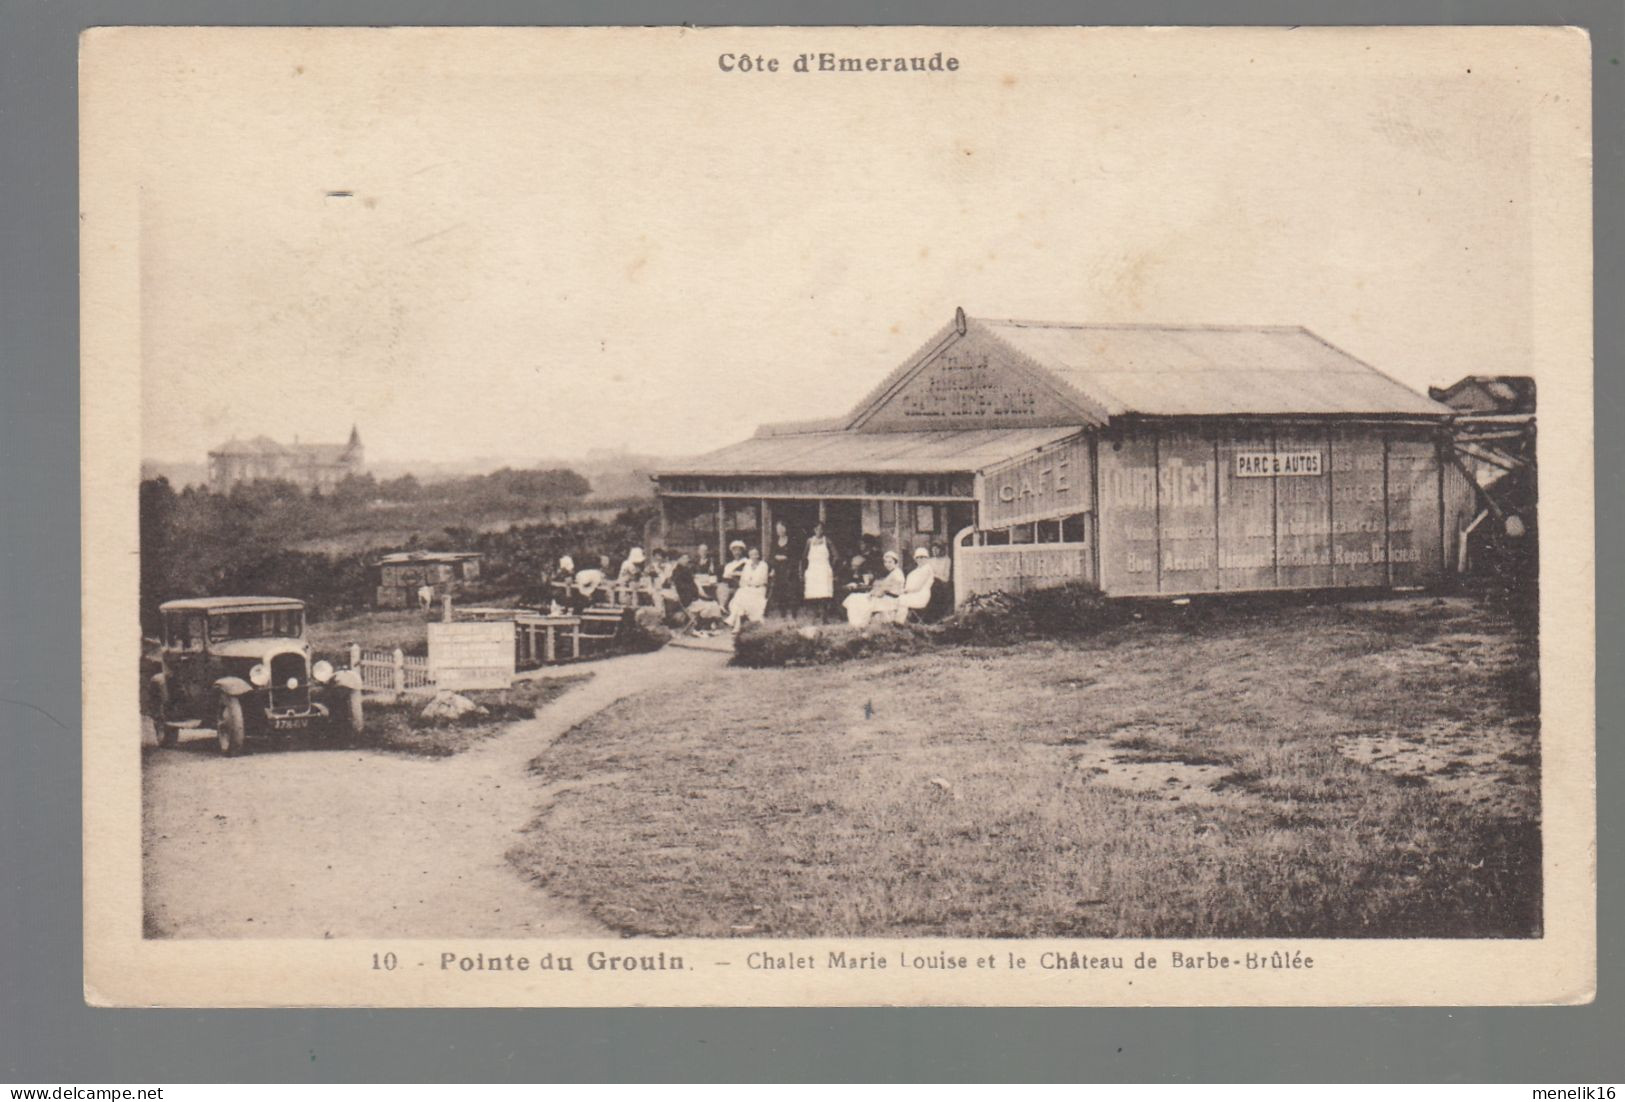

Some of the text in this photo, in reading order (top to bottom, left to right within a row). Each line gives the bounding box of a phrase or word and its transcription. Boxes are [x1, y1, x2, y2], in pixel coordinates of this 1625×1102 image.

[718, 52, 960, 73] Côte d'Emeraude
[1239, 456, 1269, 474] PARC
[1284, 455, 1319, 473] AUTOS
[1335, 544, 1370, 571] Repas
[372, 952, 398, 971] 10
[440, 952, 530, 972] Pointe
[540, 952, 574, 972] du
[746, 951, 815, 970] Chalet
[828, 951, 887, 970] Marie
[900, 951, 968, 970] Louise
[976, 953, 996, 970] et
[1008, 951, 1027, 970] le
[1040, 951, 1124, 970] Château
[1134, 952, 1157, 970] de
[1172, 950, 1314, 970] Barbe-Brûlée
